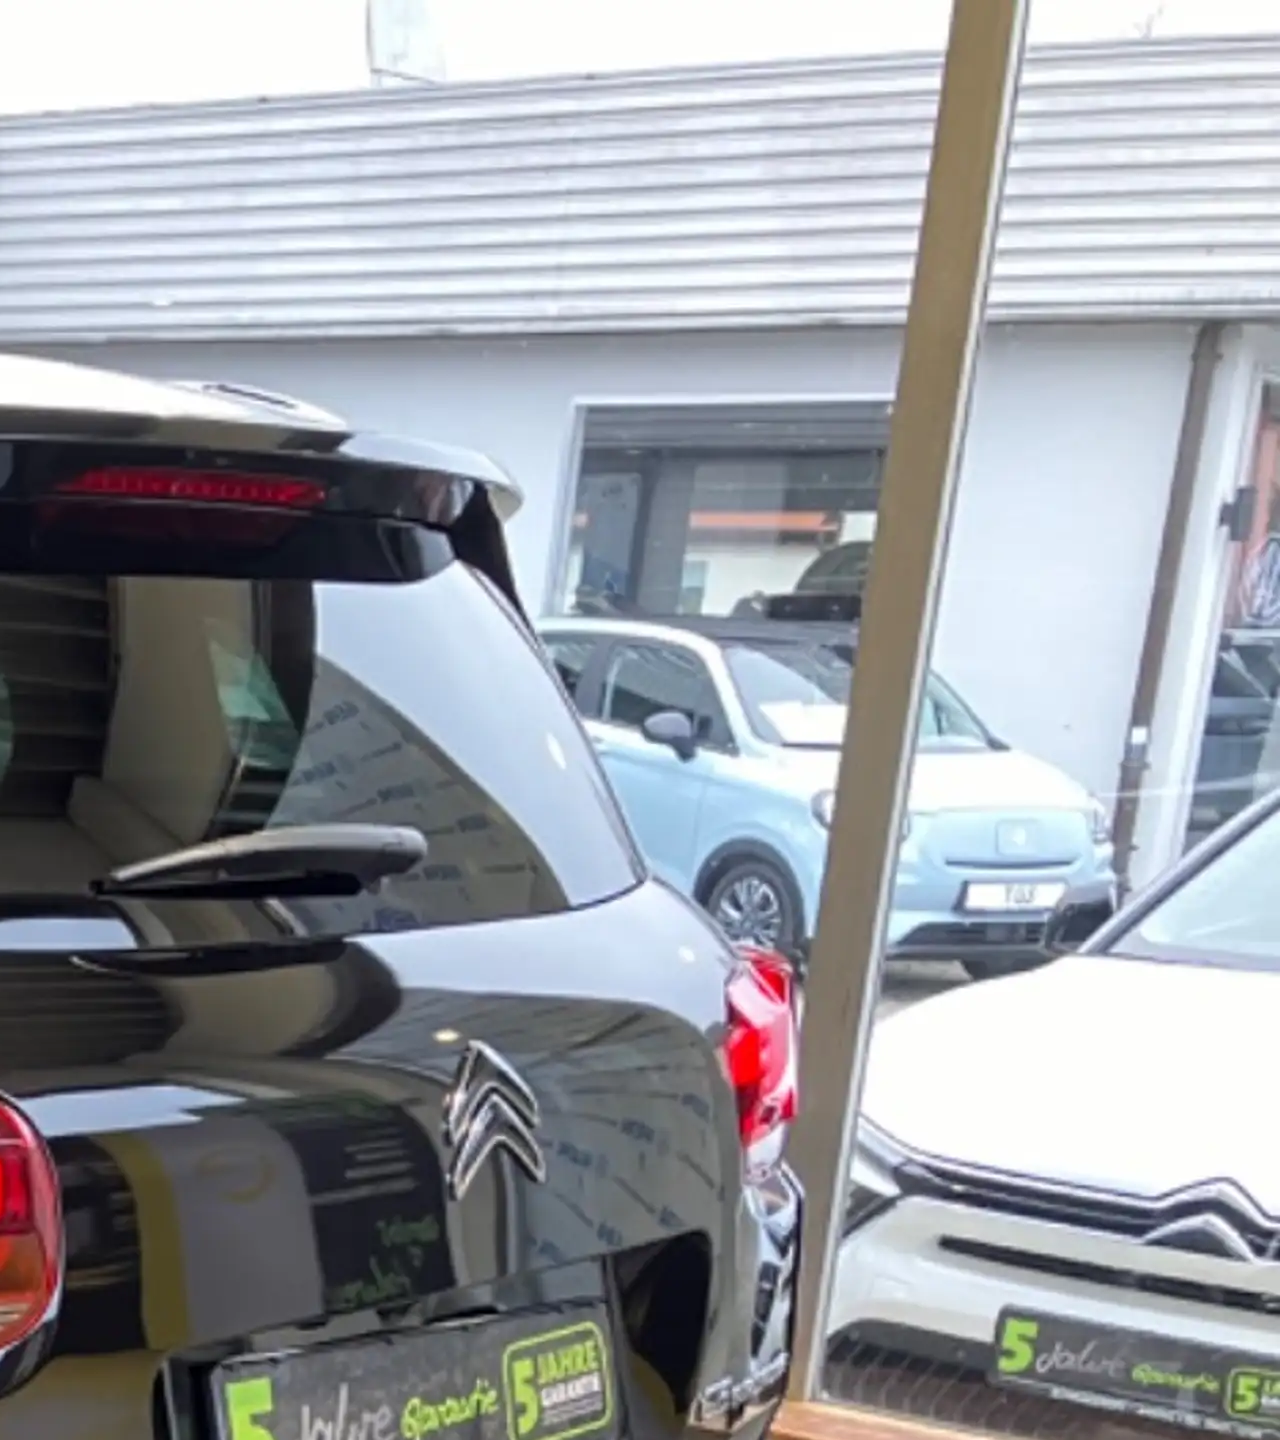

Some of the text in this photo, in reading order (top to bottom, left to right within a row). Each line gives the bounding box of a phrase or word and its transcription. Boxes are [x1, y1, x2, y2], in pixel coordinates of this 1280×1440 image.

[998, 1318, 1038, 1373] 5
[513, 1357, 538, 1434] 5
[537, 1339, 599, 1385] JAHRE
[1234, 1374, 1259, 1411] 5
